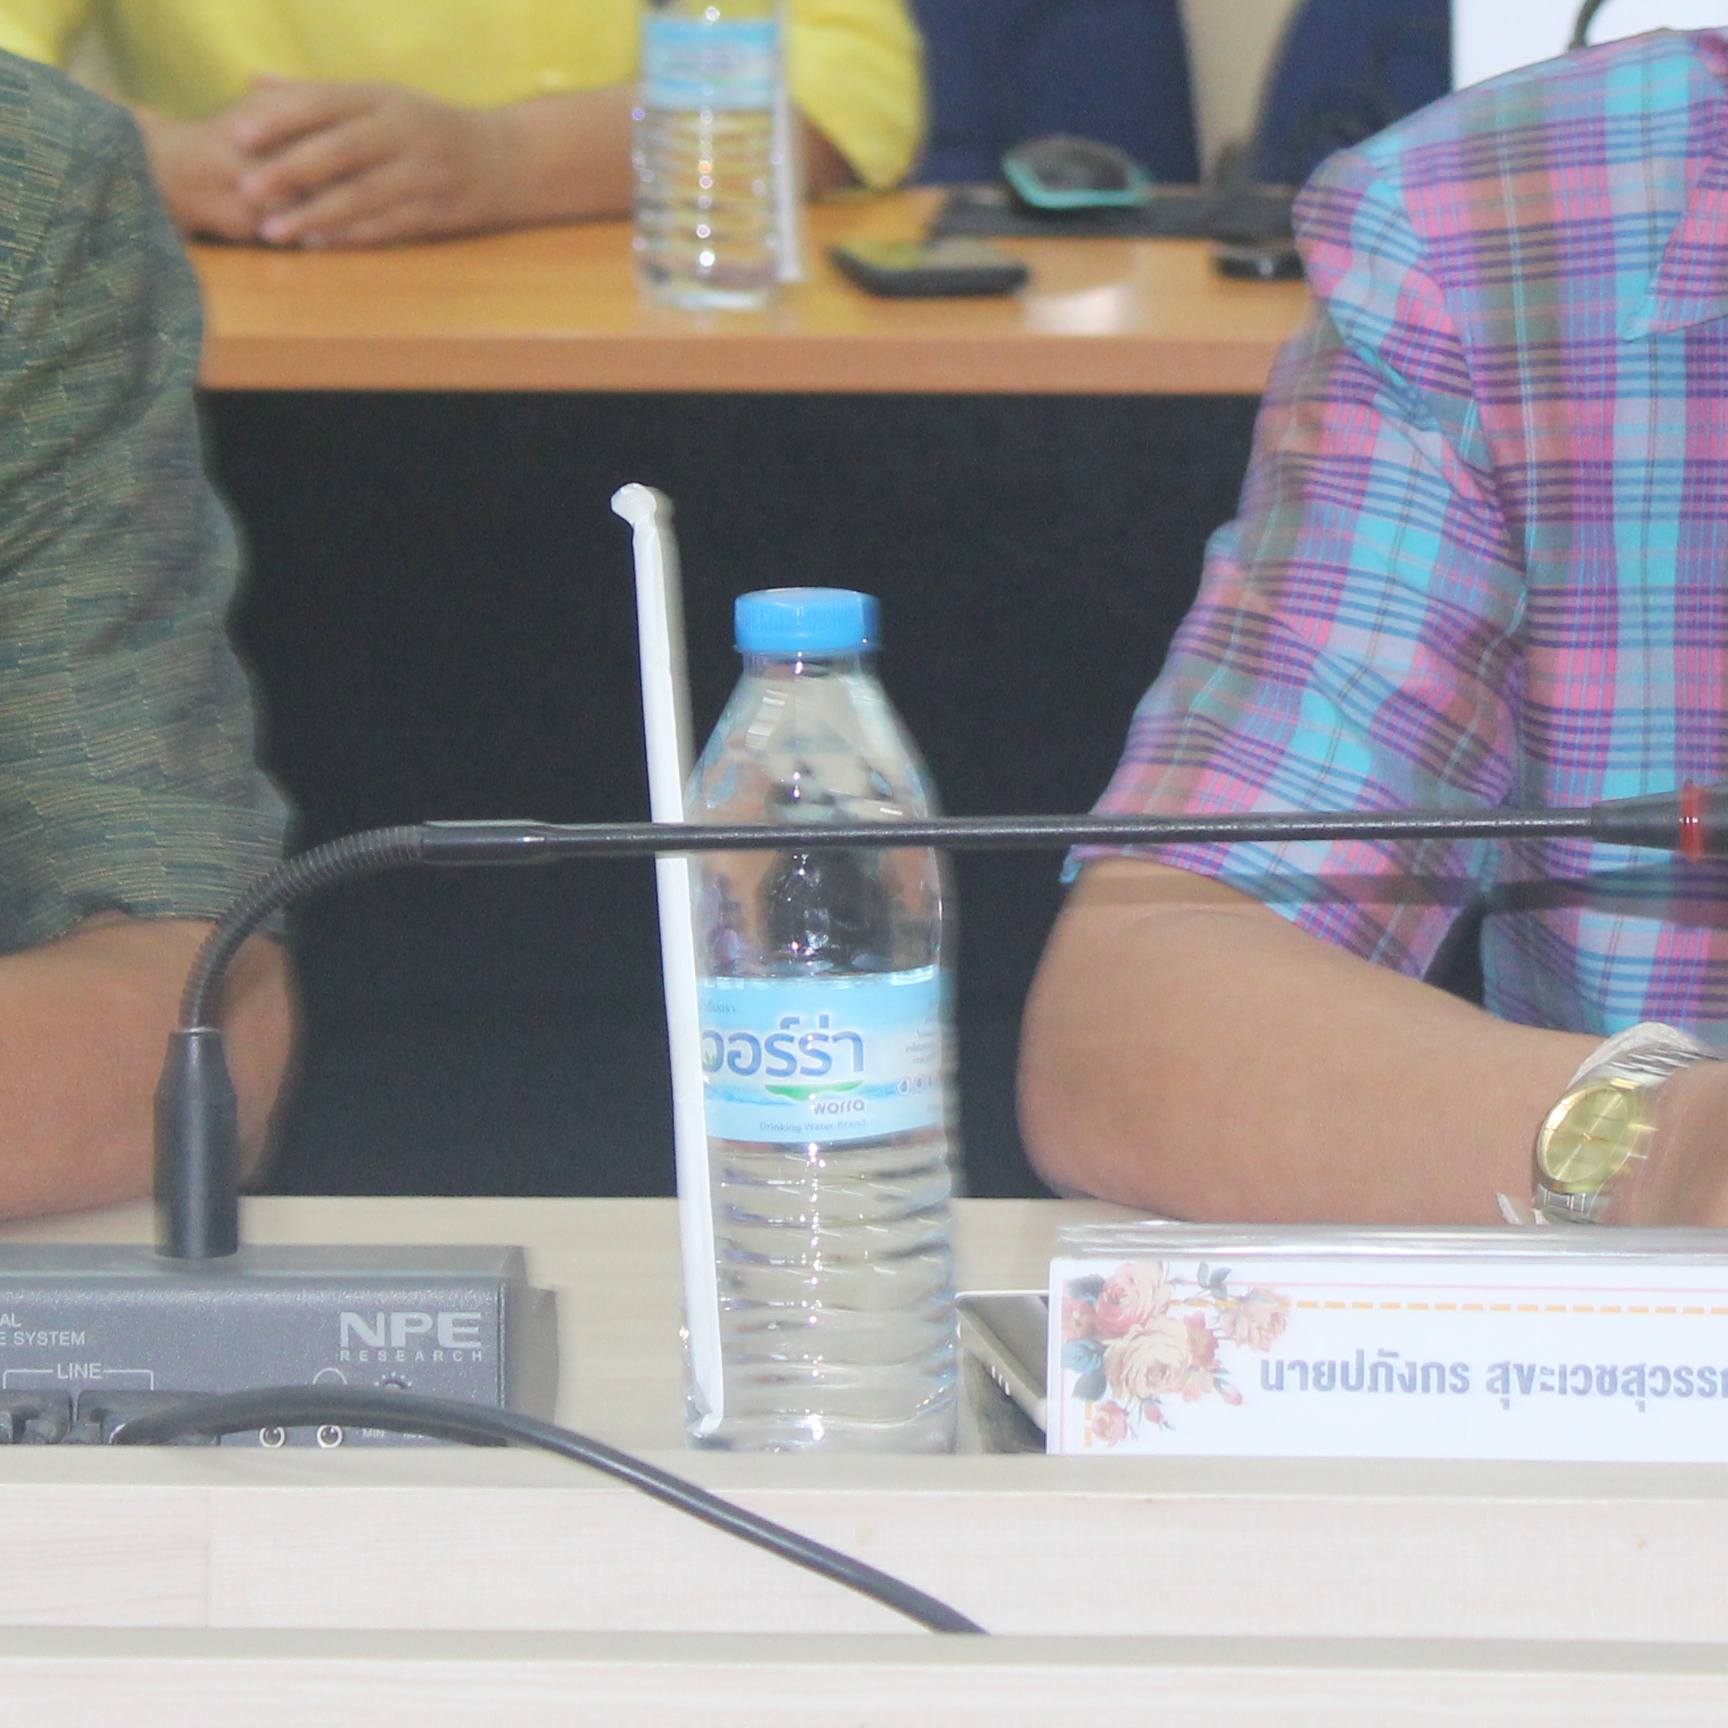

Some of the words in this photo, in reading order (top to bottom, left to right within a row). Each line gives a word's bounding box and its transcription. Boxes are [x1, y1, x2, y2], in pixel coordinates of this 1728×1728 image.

[759, 1122, 802, 1134] Drinking
[804, 1120, 834, 1132] Water
[339, 1311, 483, 1349] NPE
[12, 1331, 87, 1347] SYSTEM
[339, 1350, 483, 1363] RESEARCH
[56, 1363, 103, 1380] LINE
[1259, 1347, 1472, 1395] นายปภังกร
[362, 1427, 385, 1438] MIN
